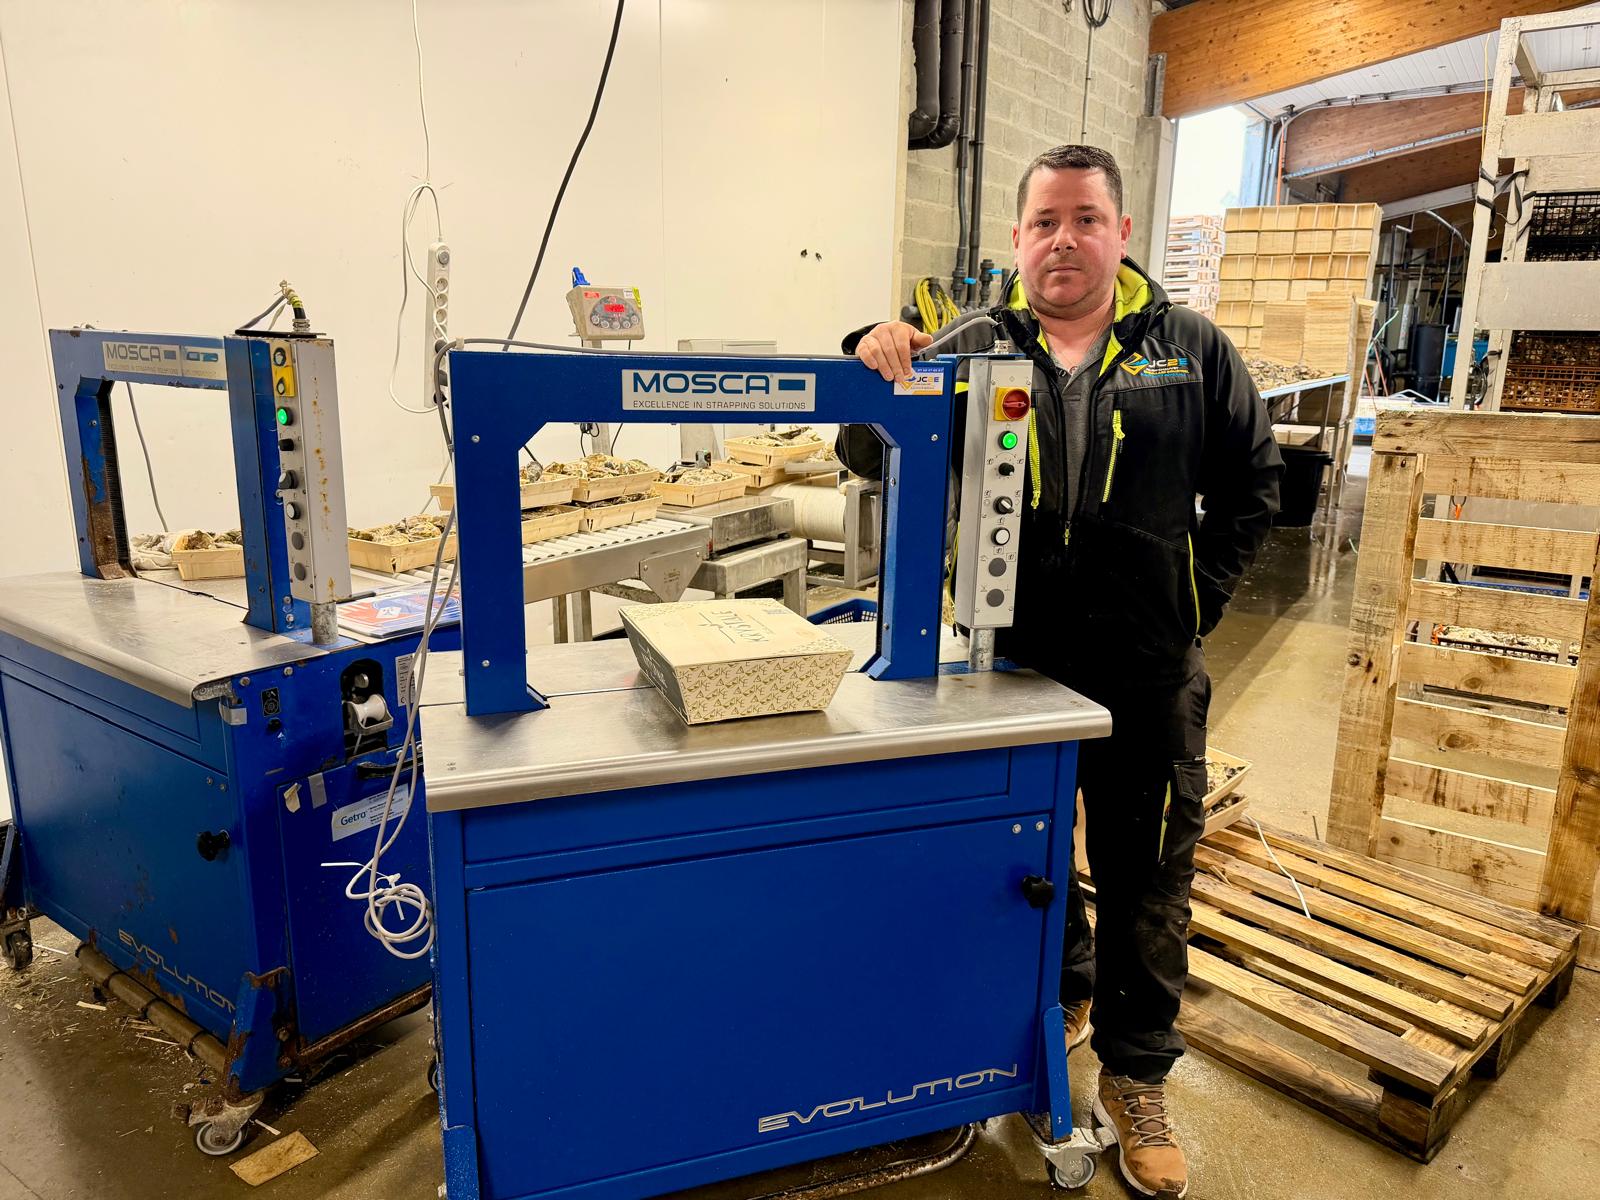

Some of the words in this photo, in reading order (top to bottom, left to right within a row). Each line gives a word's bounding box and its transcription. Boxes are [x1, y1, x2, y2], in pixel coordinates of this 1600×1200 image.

[106, 343, 162, 362] MOSCA
[633, 372, 769, 394] MOSCA
[633, 400, 690, 409] EXCELLENCE
[693, 401, 703, 409] IN
[706, 401, 756, 409] STRAPPING
[758, 402, 806, 410] SOLUTIONS
[758, 1063, 1018, 1133] EVOLUTION
